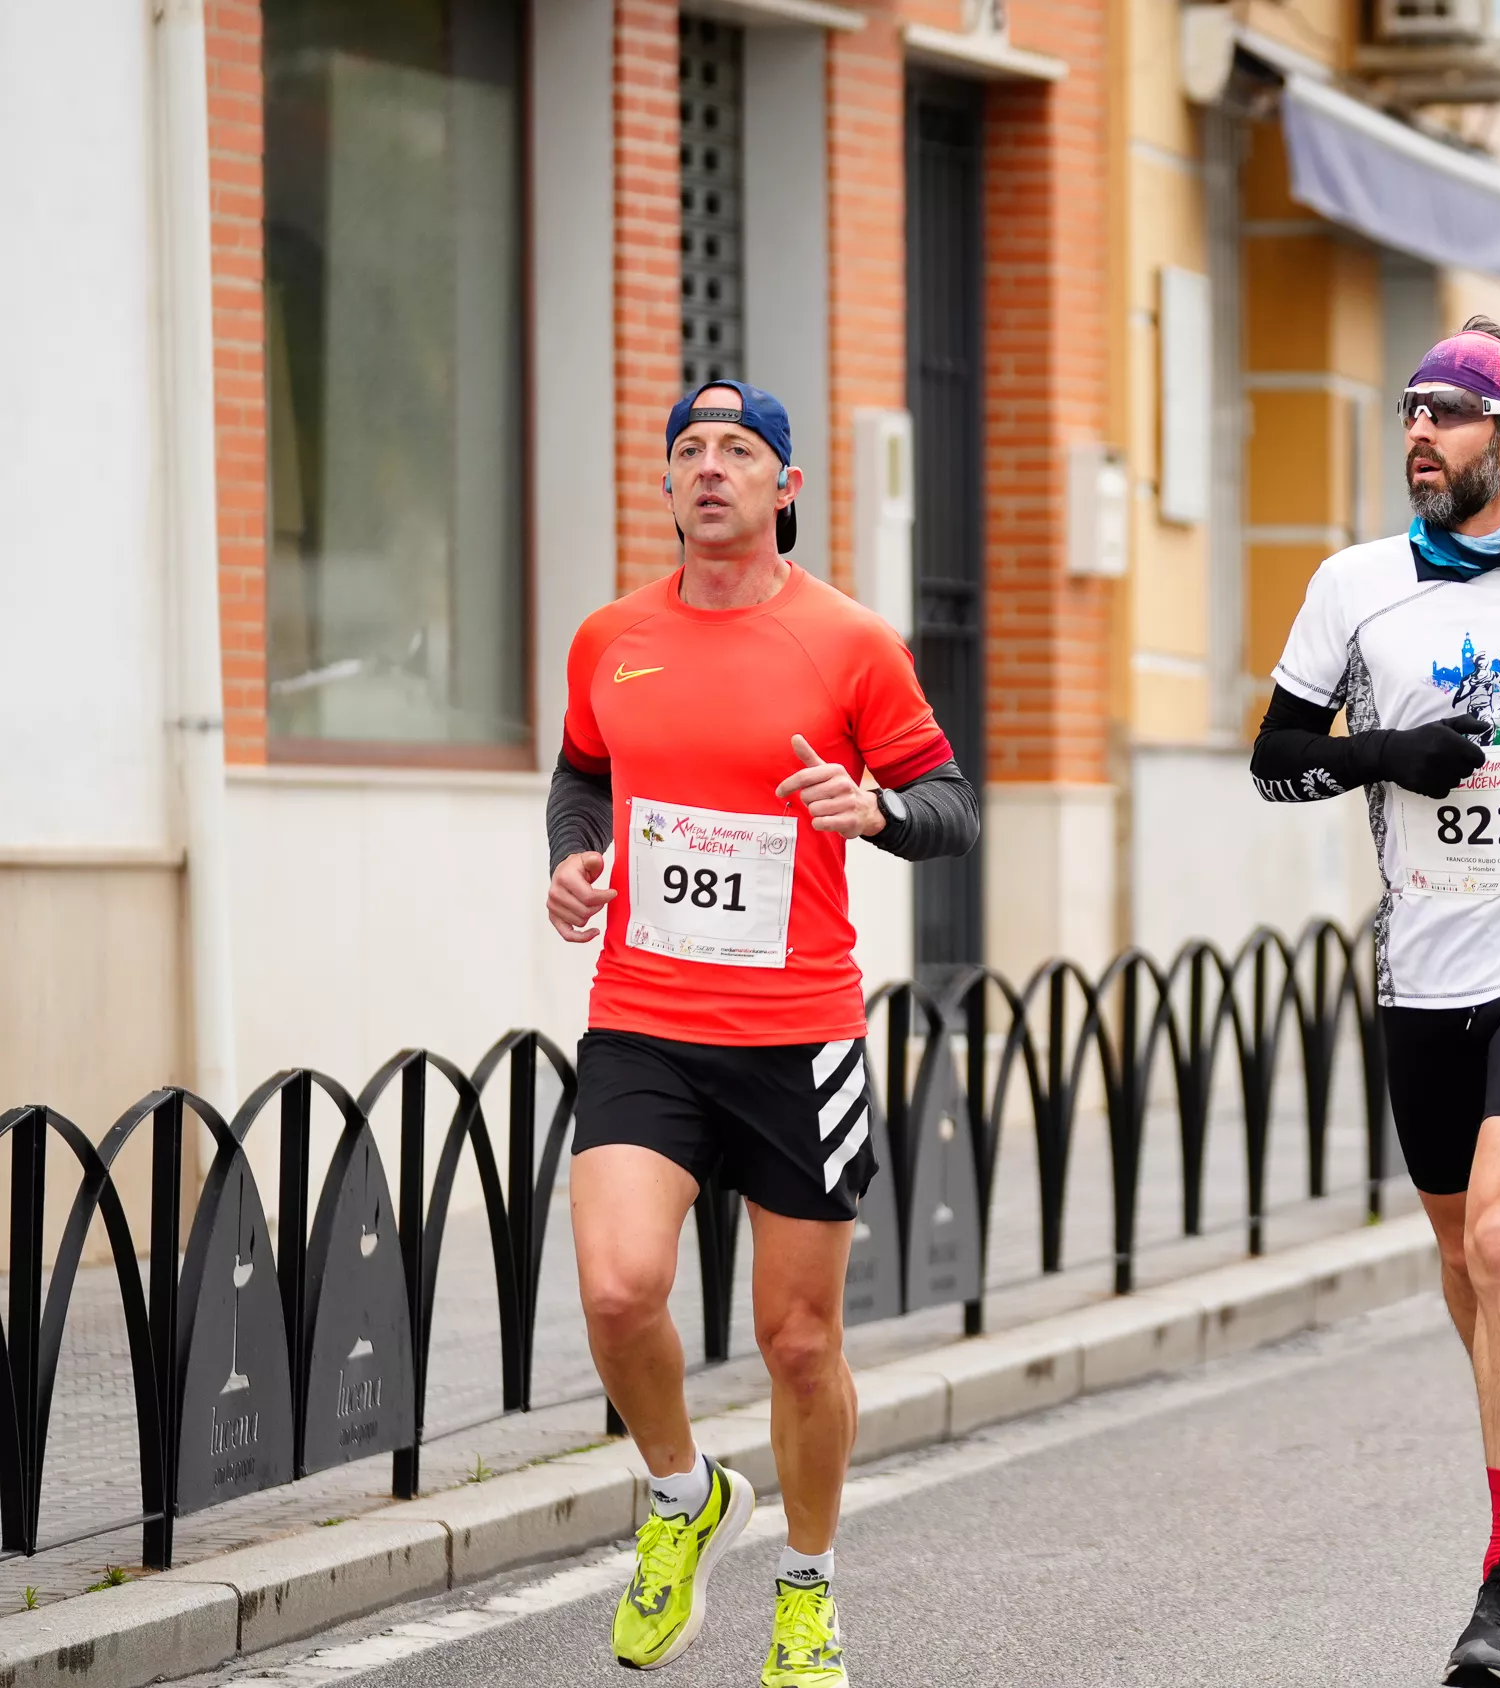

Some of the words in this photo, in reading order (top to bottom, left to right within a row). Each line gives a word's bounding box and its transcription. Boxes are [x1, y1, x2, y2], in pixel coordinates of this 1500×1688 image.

[1446, 856, 1477, 864] FRANCISCO
[663, 864, 746, 912] 981
[210, 1406, 260, 1456] lucena
